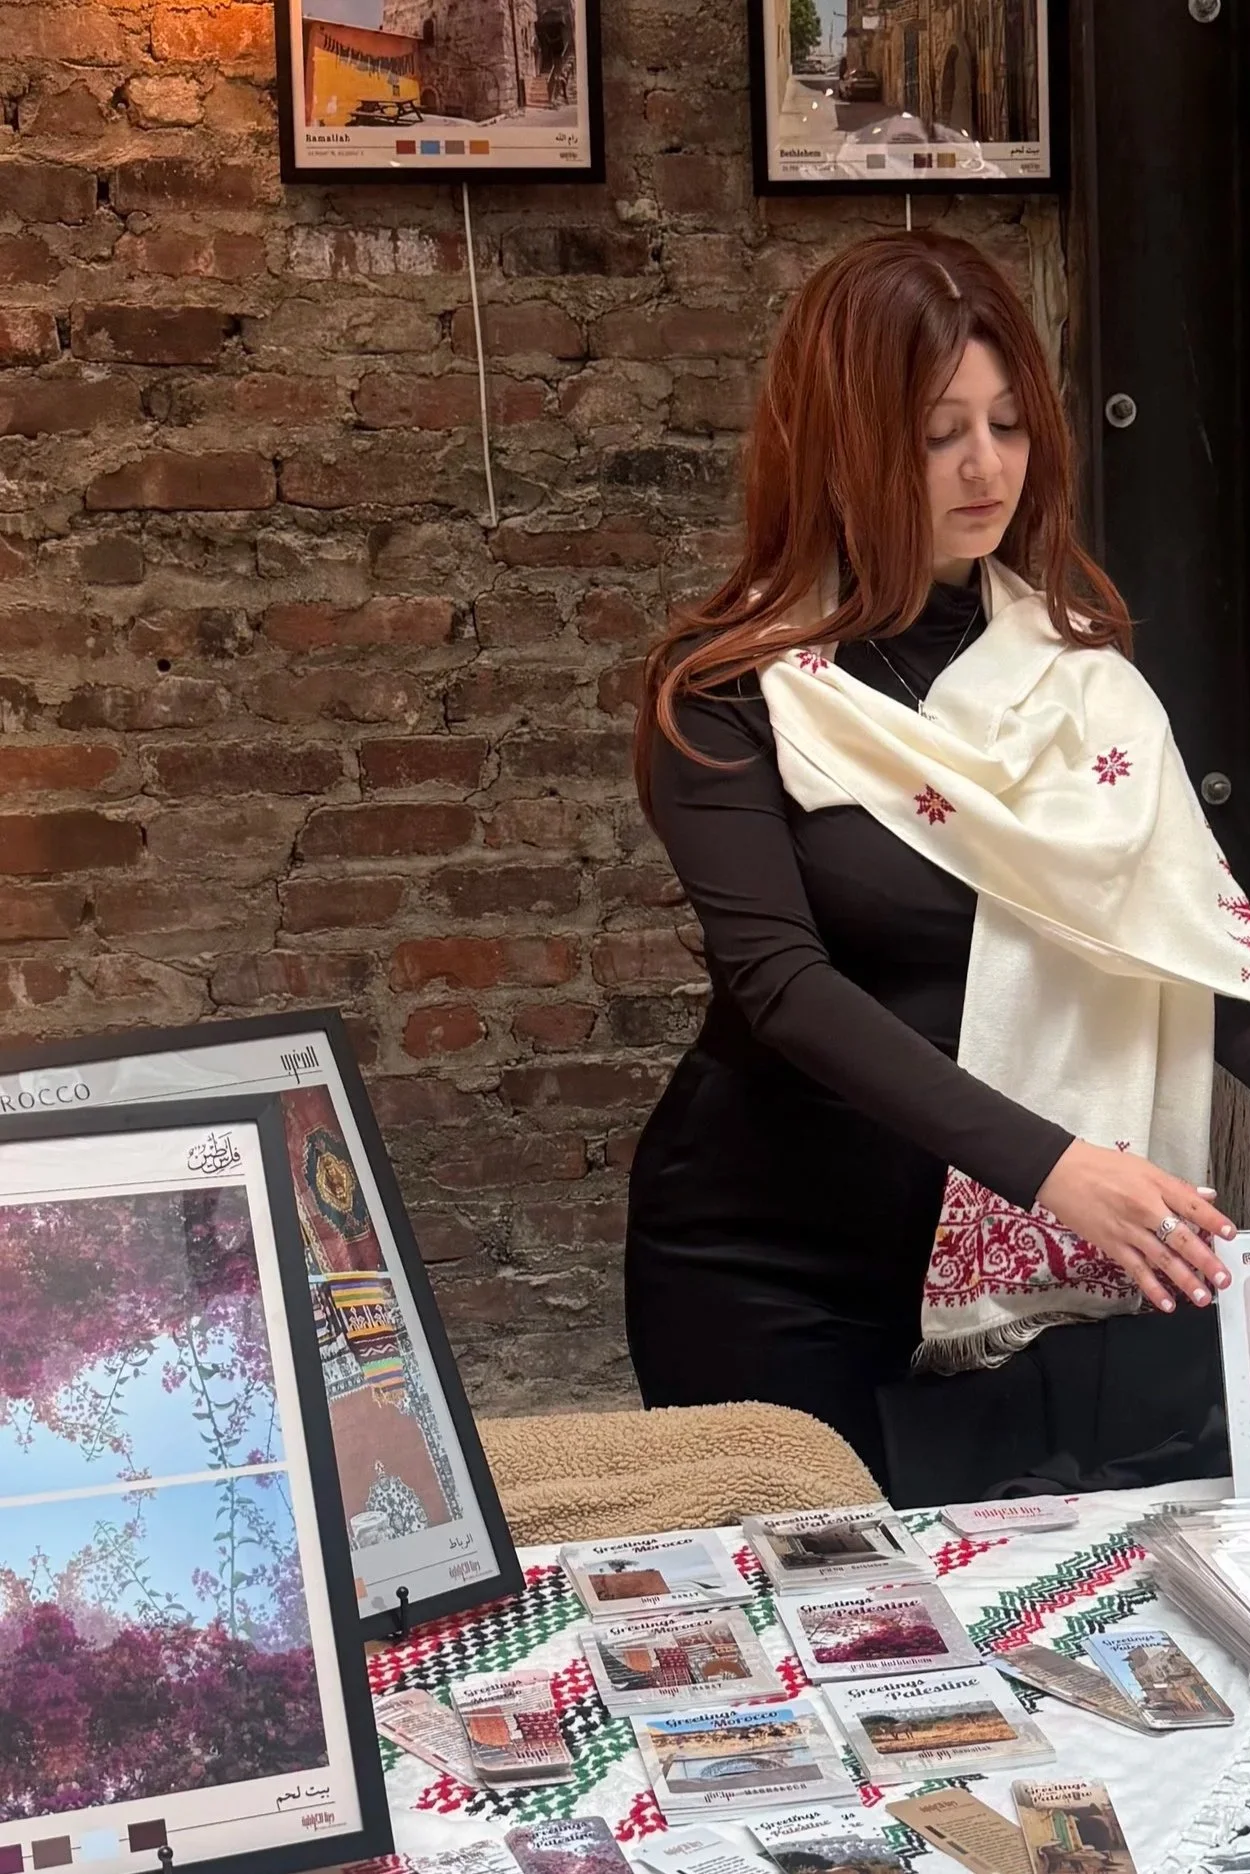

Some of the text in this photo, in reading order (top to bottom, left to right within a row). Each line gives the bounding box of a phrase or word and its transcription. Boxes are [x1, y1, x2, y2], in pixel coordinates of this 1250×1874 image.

[306, 133, 351, 142] Ramallah
[780, 149, 821, 158] Bethlehem
[763, 1512, 830, 1527] Greetings
[795, 1511, 876, 1531] Palestine
[593, 1538, 659, 1554] Greetings
[632, 1538, 694, 1553] Morocco
[800, 1597, 873, 1613] Greetings
[832, 1599, 920, 1617] Palestine
[609, 1619, 676, 1636] Greetings
[651, 1620, 713, 1635] Morocco
[1102, 1634, 1155, 1647] Greetings
[1110, 1641, 1162, 1652] Palestine
[463, 1679, 522, 1698] Greetings
[848, 1678, 925, 1698] Greetings
[886, 1677, 981, 1700] Palestine
[665, 1710, 738, 1728] Greetings
[710, 1710, 778, 1728] Morocco
[1024, 1783, 1087, 1795] Greetings
[1031, 1791, 1093, 1803] Palestne
[276, 1785, 330, 1811] بيت لحم
[760, 1811, 821, 1830] Greetings
[770, 1820, 832, 1837] Palestine
